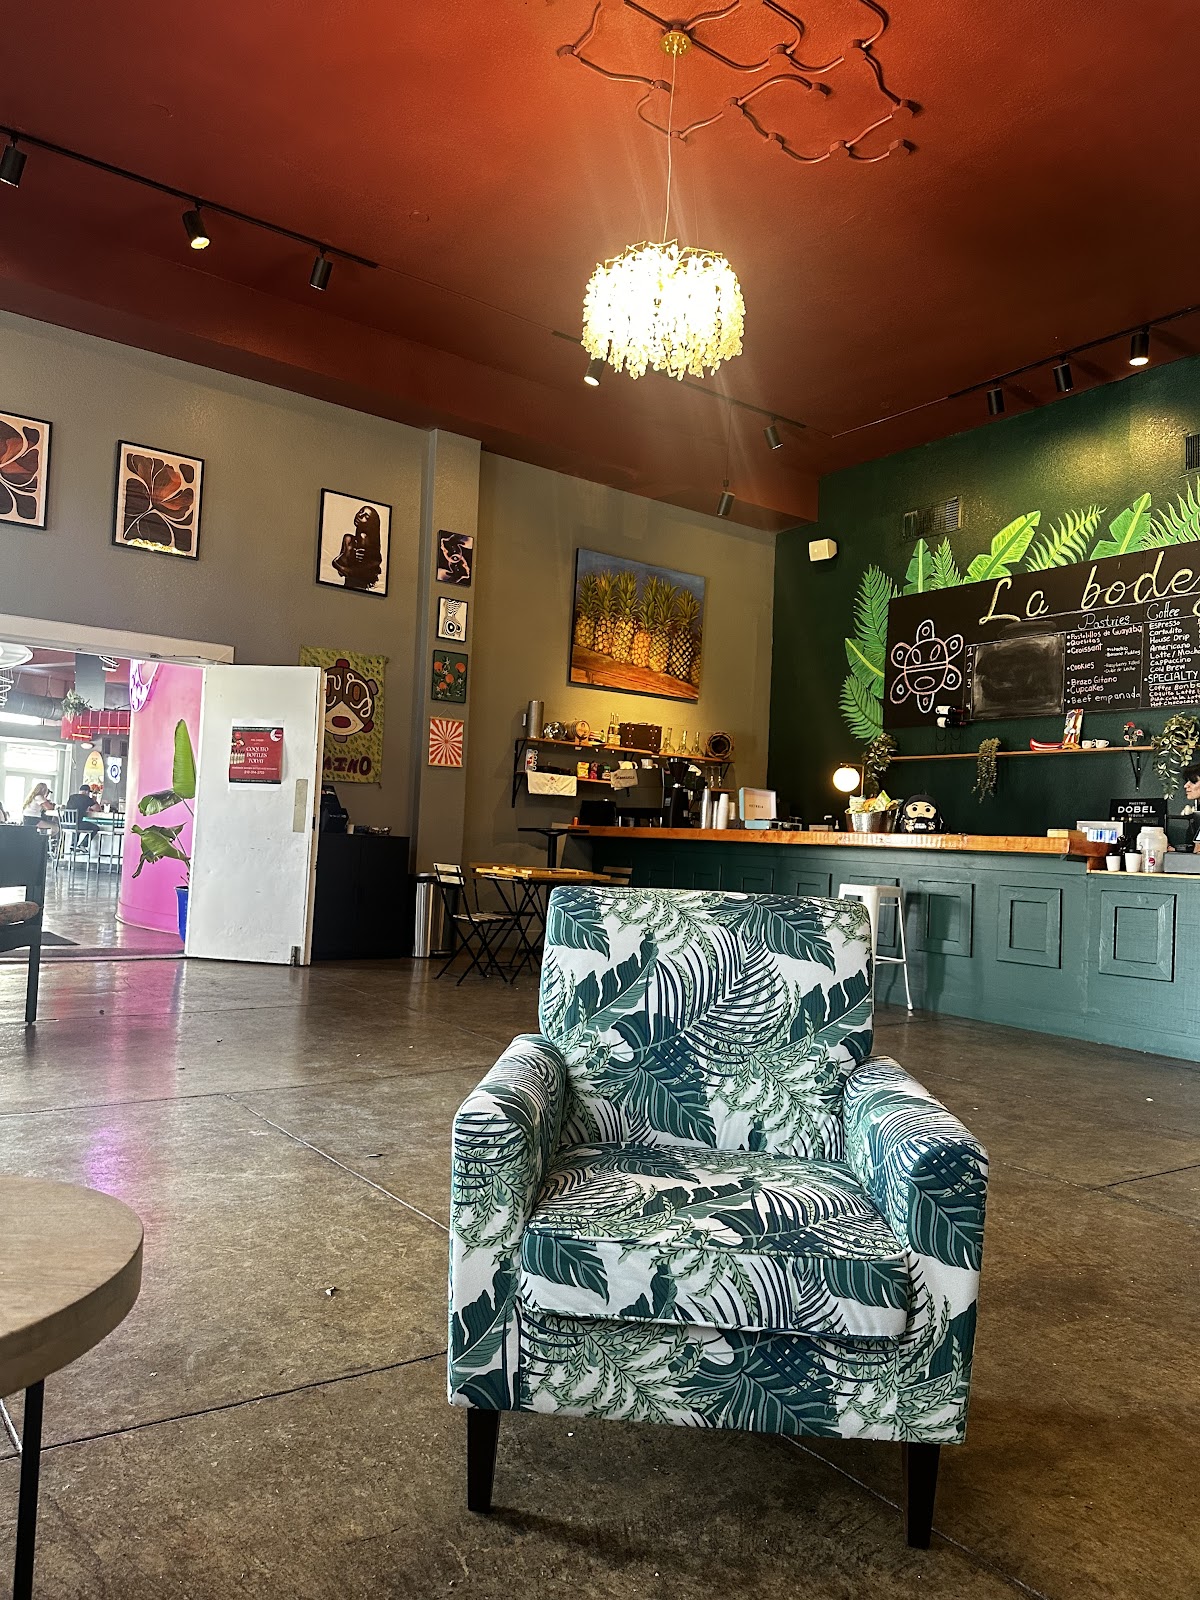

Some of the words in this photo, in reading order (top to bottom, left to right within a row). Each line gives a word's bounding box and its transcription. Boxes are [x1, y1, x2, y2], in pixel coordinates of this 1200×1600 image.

[979, 577, 1049, 625] La
[1080, 551, 1200, 610] bode
[1147, 601, 1180, 620] Coffee
[1078, 613, 1130, 630] Pastries
[1149, 620, 1180, 630] Espresso
[1112, 625, 1143, 636] Guayaba
[1149, 628, 1183, 637] Cortadito
[1150, 636, 1171, 644] House
[1173, 634, 1190, 642] Drip
[966, 646, 974, 657] 1
[1070, 643, 1103, 654] Croissant
[1150, 643, 1191, 652] Americano
[966, 662, 972, 673] 2
[1070, 661, 1095, 672] Cookies
[1150, 657, 1192, 667] Cappuccino
[1150, 665, 1165, 673] Cold
[1166, 664, 1186, 672] Brew
[1070, 678, 1092, 686] Brazo
[1093, 674, 1118, 684] Gitano
[1148, 671, 1199, 683] SPECIALTY
[966, 678, 972, 689] 3
[1070, 683, 1105, 695] Cupcakes
[1071, 694, 1092, 704] Beef
[1095, 686, 1141, 704] empanada
[323, 755, 372, 776] AINO
